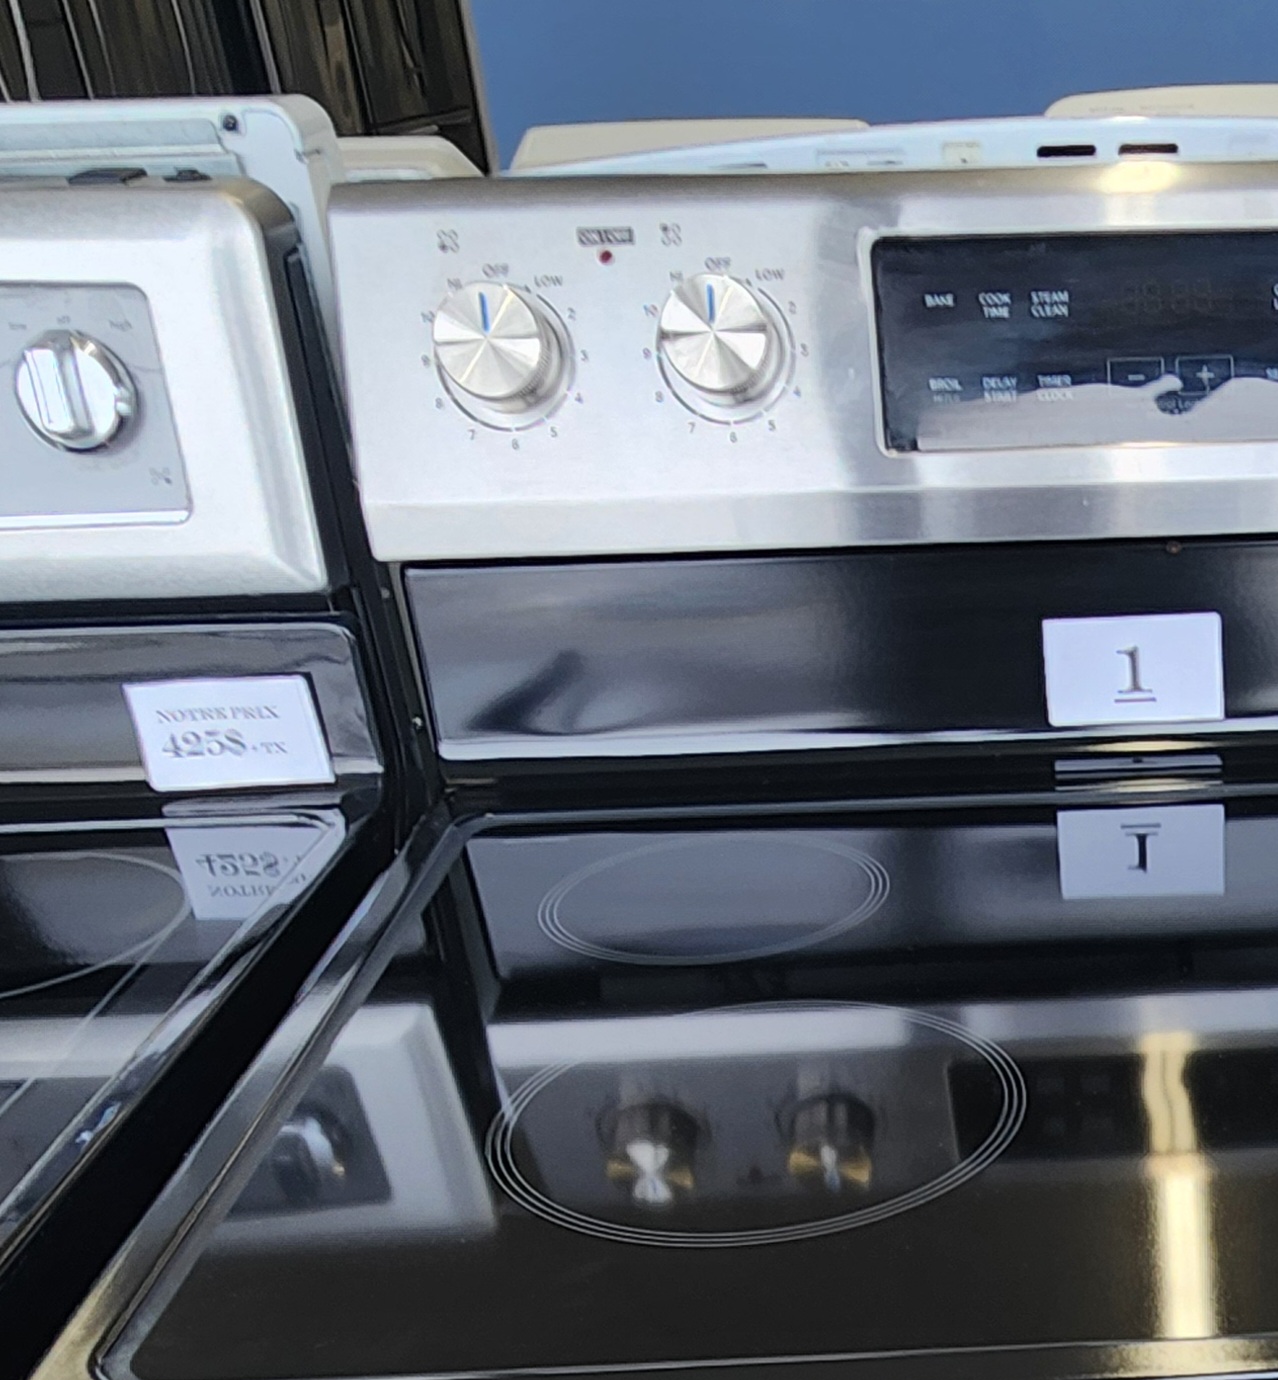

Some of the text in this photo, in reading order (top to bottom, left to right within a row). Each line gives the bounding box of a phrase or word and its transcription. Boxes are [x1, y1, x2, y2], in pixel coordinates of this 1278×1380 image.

[704, 257, 731, 272] OFF
[754, 268, 785, 281] LOW
[534, 275, 563, 288] LOW
[924, 293, 955, 308] BAKE
[978, 292, 1011, 305] COOK
[1030, 290, 1070, 304] STEAM
[983, 306, 1010, 318] TIME
[1030, 305, 1069, 318] CLEAN
[982, 376, 1017, 390] DELAY
[1115, 645, 1153, 694] 1
[156, 705, 281, 724] NOTRE PRIX
[260, 741, 288, 754] TX
